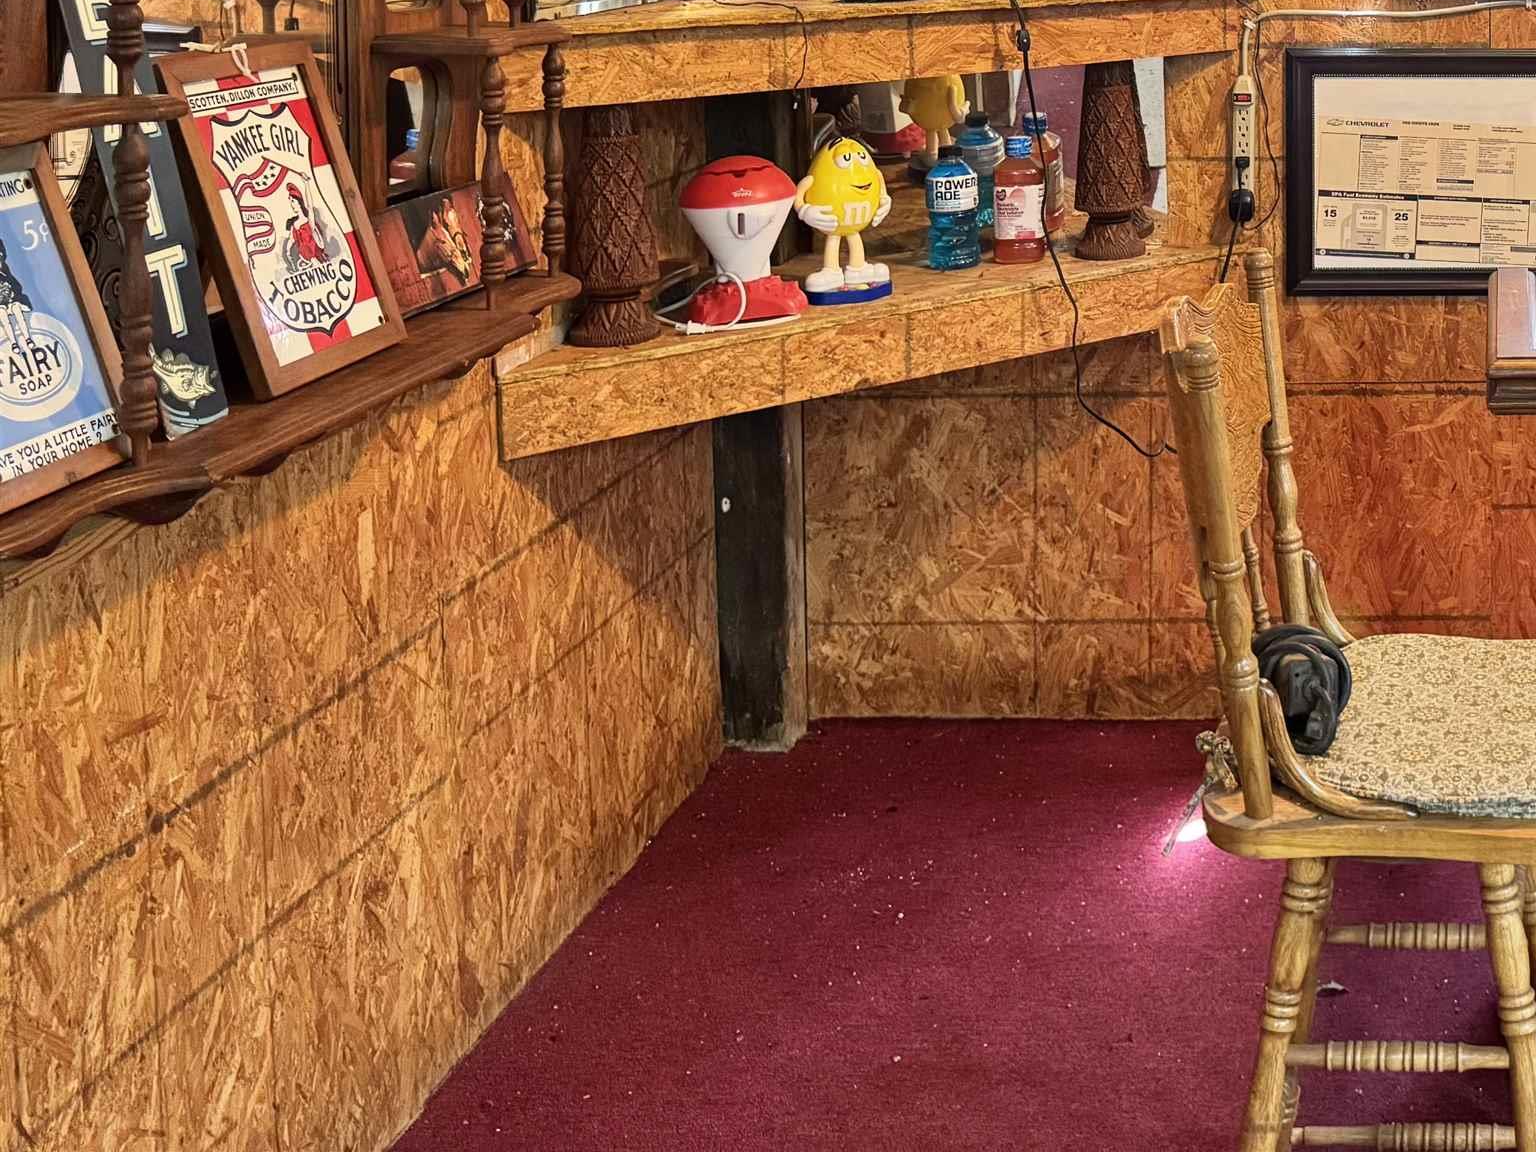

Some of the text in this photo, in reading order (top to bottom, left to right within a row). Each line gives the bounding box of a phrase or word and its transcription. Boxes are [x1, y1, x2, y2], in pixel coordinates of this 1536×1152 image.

[230, 88, 256, 102] DILLON
[1345, 120, 1389, 128] CHEVROLET
[216, 123, 305, 172] YANKEE GIRL
[935, 177, 977, 191] POWER
[935, 191, 961, 201] ADE
[245, 212, 265, 221] UNION
[1323, 209, 1337, 218] 15
[1394, 212, 1409, 221] 25
[253, 238, 271, 248] MADE
[284, 263, 337, 295] CHEWING
[269, 259, 353, 324] TOBACCO
[19, 374, 52, 395] SOAP
[16, 443, 40, 460] YOU
[44, 438, 52, 449] A
[55, 424, 87, 446] LITTLE
[90, 412, 119, 432] FAIRY
[12, 432, 103, 477] IN YOUR HOME ?
